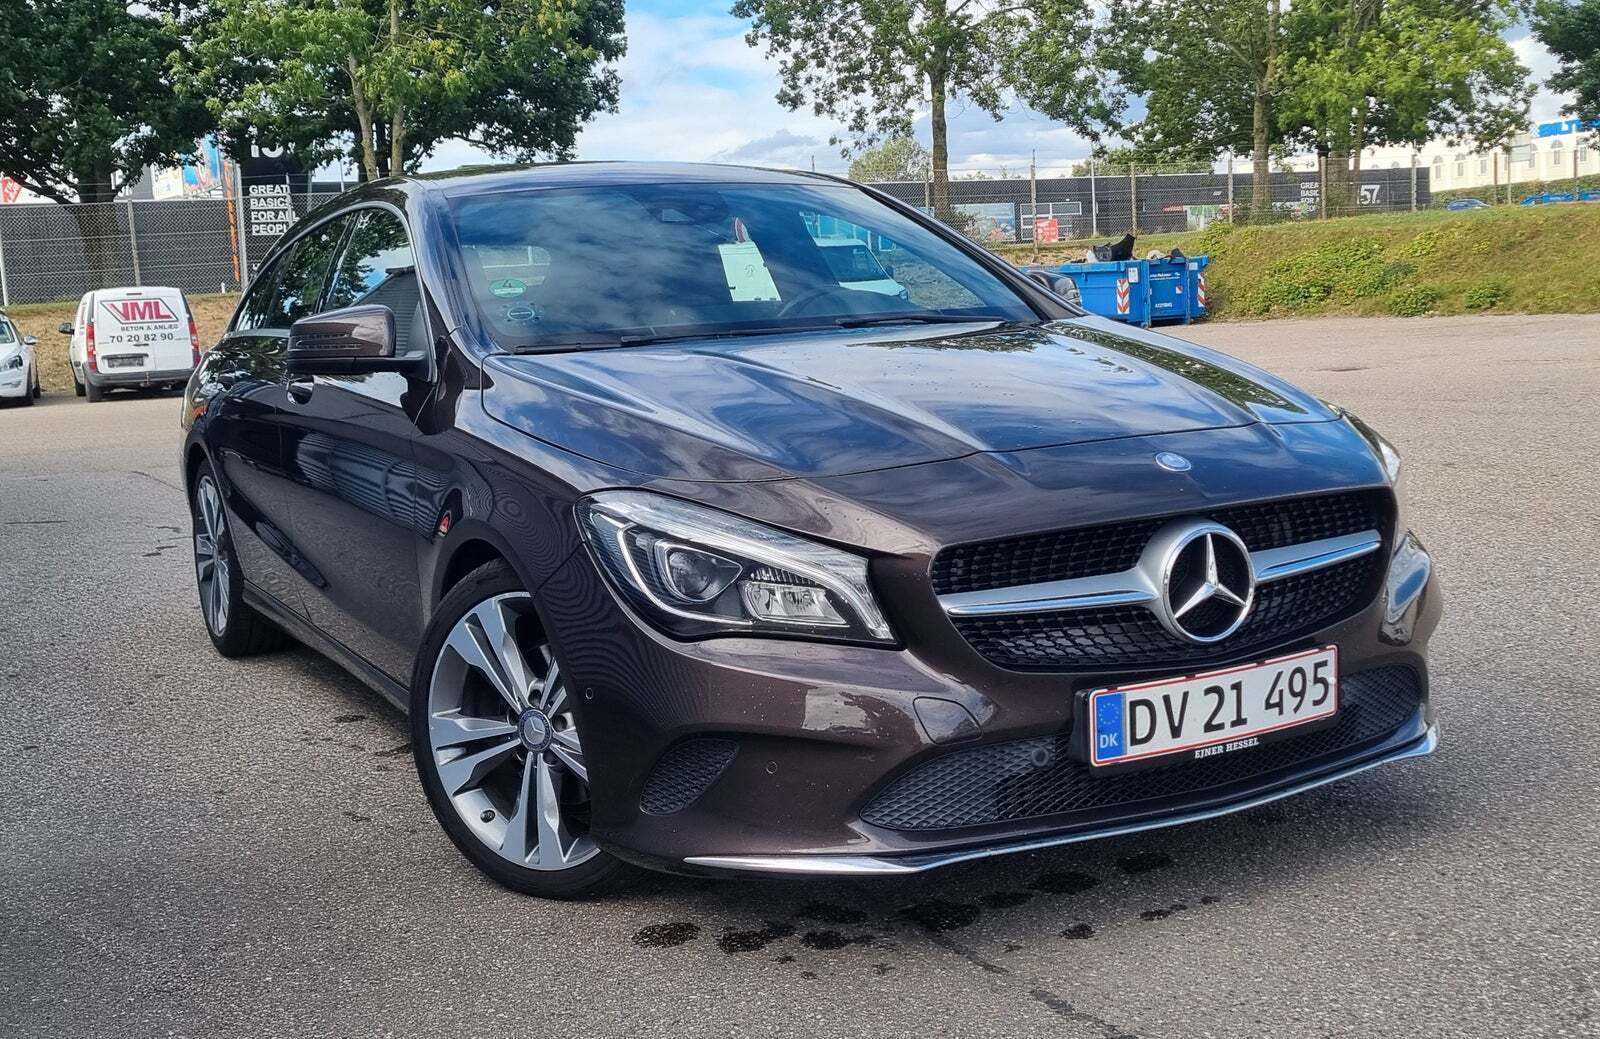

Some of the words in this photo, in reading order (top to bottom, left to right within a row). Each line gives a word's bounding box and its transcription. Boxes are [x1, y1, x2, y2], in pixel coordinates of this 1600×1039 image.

[249, 185, 289, 194] GREAT
[251, 211, 276, 220] FOR
[252, 224, 287, 233] PEOPL
[107, 301, 173, 321] VML
[110, 335, 123, 343] 70
[127, 334, 140, 342] 20
[144, 333, 157, 341] 82
[160, 333, 174, 341] 90
[1128, 690, 1190, 747] DV
[1203, 680, 1248, 733] 21
[1264, 659, 1329, 717] 495
[1100, 733, 1118, 748] DK
[1194, 745, 1224, 759] EJNER
[1226, 737, 1260, 752] HESSEL
